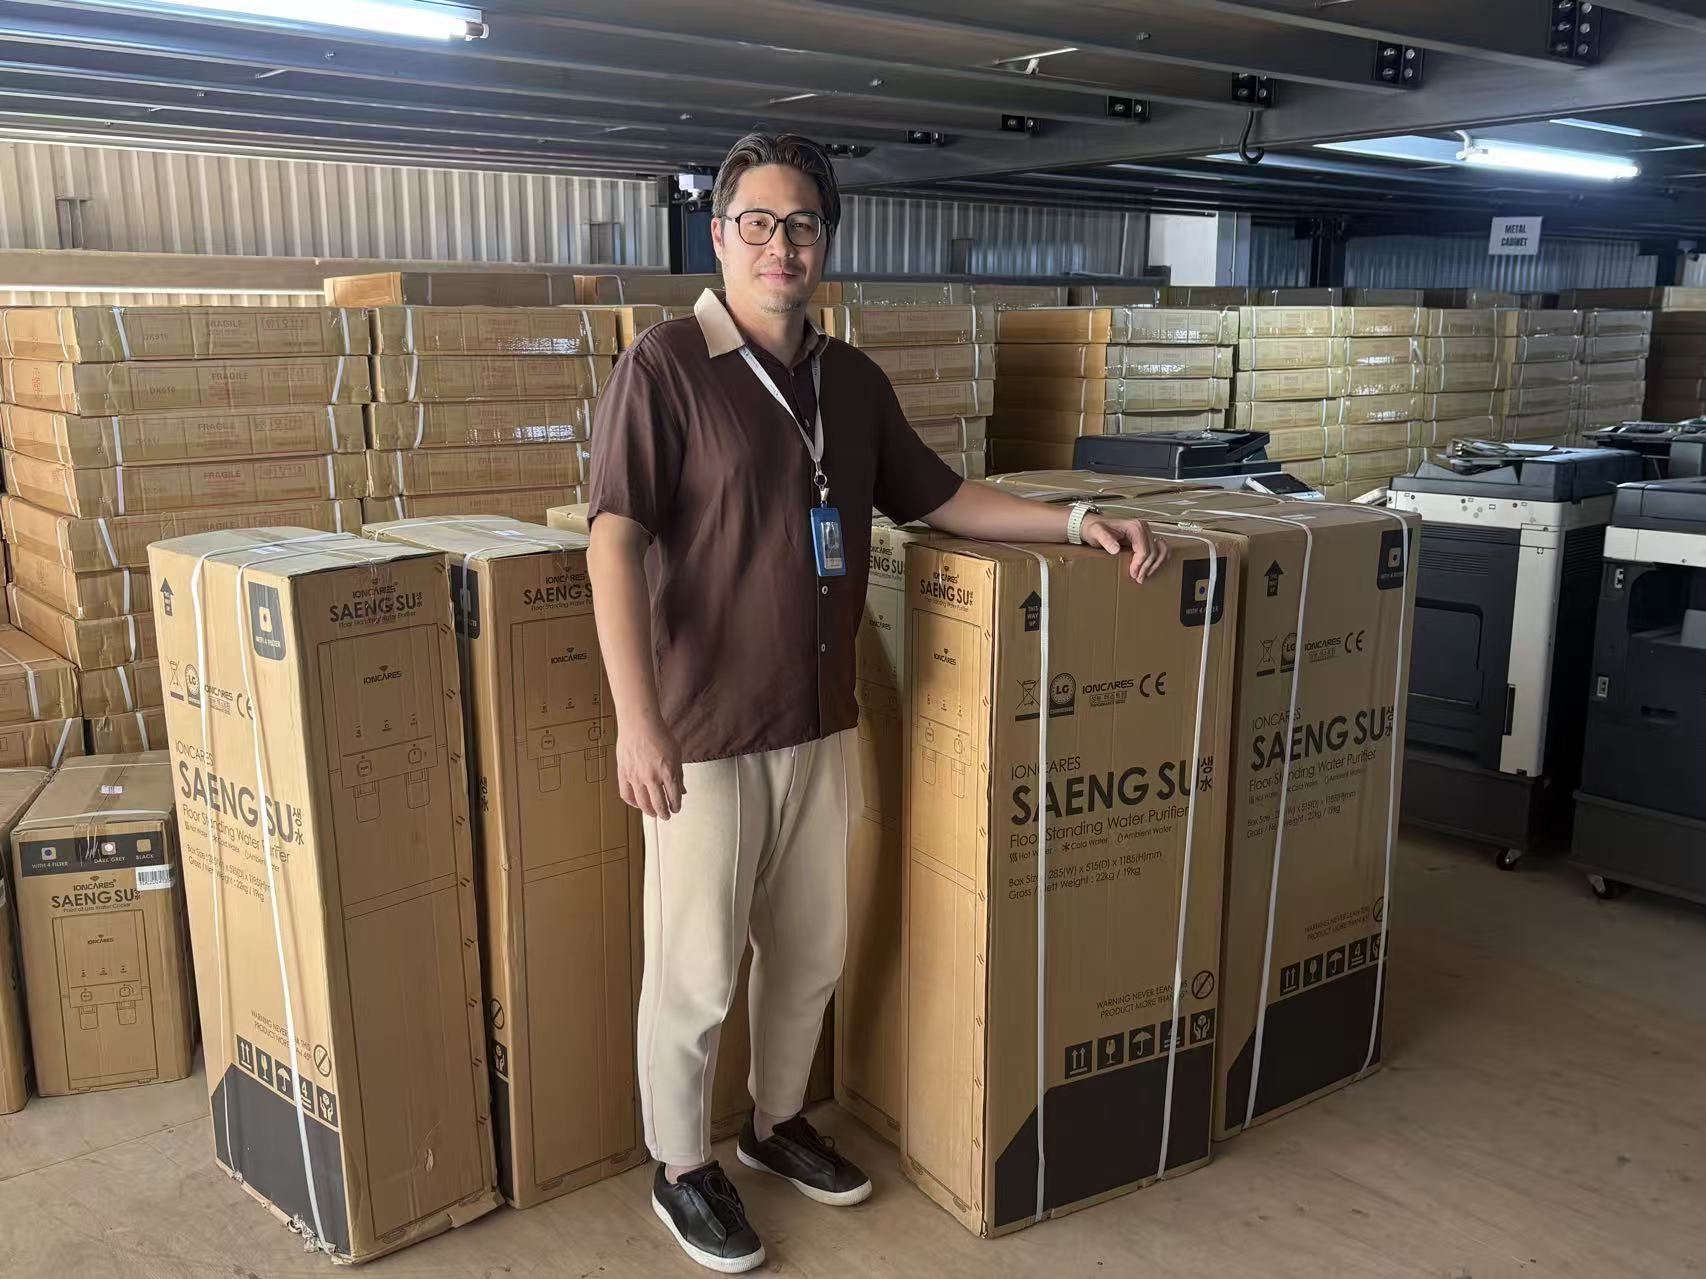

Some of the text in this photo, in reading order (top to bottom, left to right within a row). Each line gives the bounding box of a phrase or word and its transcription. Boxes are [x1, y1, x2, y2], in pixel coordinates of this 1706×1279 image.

[1504, 224, 1527, 234] METAL
[206, 319, 243, 329] RAGILE
[211, 372, 249, 381] FRAGILE
[203, 470, 241, 480] FRAGILE
[870, 545, 893, 556] ONCARES
[869, 555, 904, 576] ENG SU
[352, 585, 396, 599] IONCARES
[523, 582, 593, 606] SAENG S
[920, 579, 955, 602] SAENG
[956, 588, 970, 606] SU
[329, 598, 394, 622] SAENG
[396, 593, 416, 611] SU
[1027, 612, 1039, 620] WAY
[1286, 643, 1296, 652] LG
[1304, 637, 1342, 652] IONCARES
[1344, 630, 1366, 654] CE
[551, 652, 588, 664] IONCARES
[933, 652, 957, 666] IONCARES
[363, 670, 402, 685] IONCARES
[1082, 679, 1134, 694] IONCARES
[1139, 672, 1167, 698] CE
[204, 683, 234, 701] ONCARES
[1056, 684, 1069, 695] LG
[1251, 706, 1386, 772] SAENG SU
[1249, 749, 1377, 792] Floor Stnding Water Purifier
[179, 760, 294, 843] SAENG SU
[1011, 760, 1199, 826] SAENG SU
[182, 803, 201, 822] Floor
[201, 811, 235, 842] Stnding
[1010, 805, 1189, 849] Floo Standing Water Purifier
[1124, 826, 1172, 840] Ambient Water
[1070, 840, 1088, 850] Cold
[1009, 878, 1024, 888] Box
[1026, 874, 1039, 884] Siz
[1086, 858, 1110, 872] 515(D)
[73, 881, 115, 892] IONCARES
[1008, 888, 1032, 900] Gross
[1060, 875, 1089, 889] Weight
[1096, 872, 1114, 882] 22kg
[1124, 866, 1141, 877] 19kg
[51, 888, 134, 909] SAENG SU
[1096, 993, 1131, 1009] WARNING
[1132, 987, 1155, 1000] NEVER
[1100, 1005, 1134, 1018] PRODUCT
[1135, 1000, 1156, 1010] MORE
